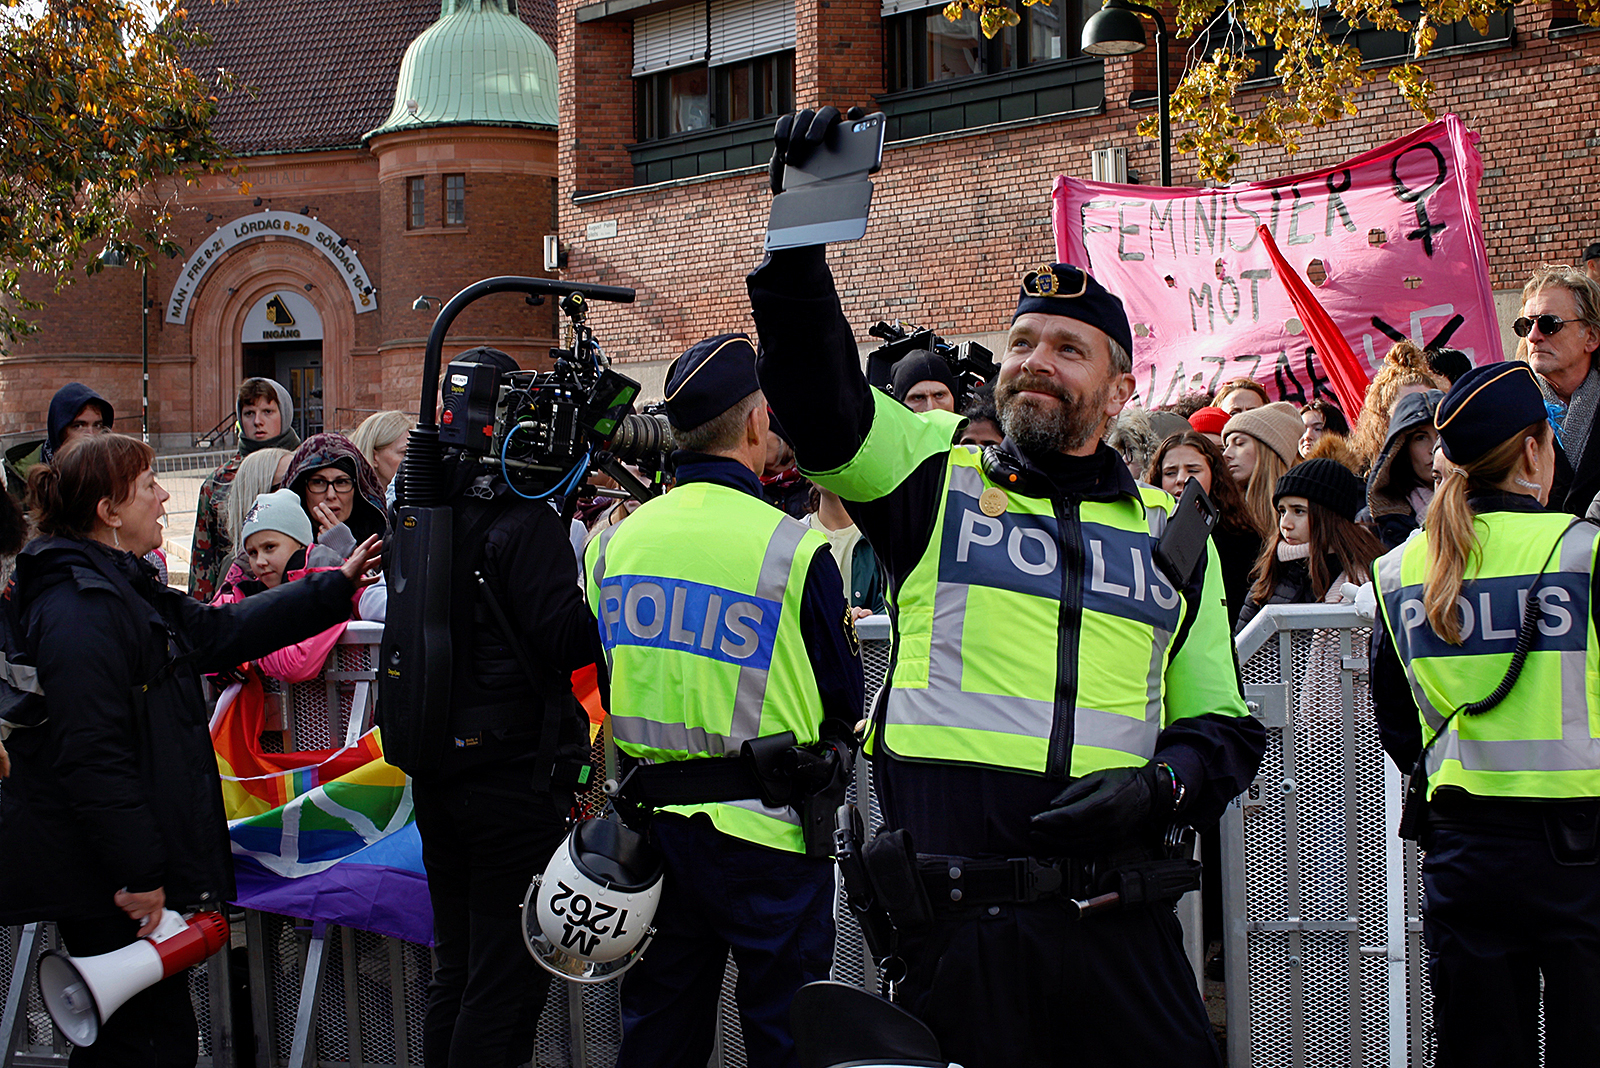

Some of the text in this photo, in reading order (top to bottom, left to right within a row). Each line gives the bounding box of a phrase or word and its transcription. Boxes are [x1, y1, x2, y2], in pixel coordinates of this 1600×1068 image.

[234, 219, 281, 238] LÖRDAG
[315, 231, 356, 275] SÖNDAG
[171, 291, 189, 319] MÅN
[187, 257, 207, 282] FRE
[204, 237, 226, 260] 8-21
[263, 327, 301, 339] INGÅNG
[956, 508, 1180, 610] POLIS
[600, 582, 764, 659] POLIS
[549, 881, 629, 939] 1262
[561, 922, 601, 957] M
